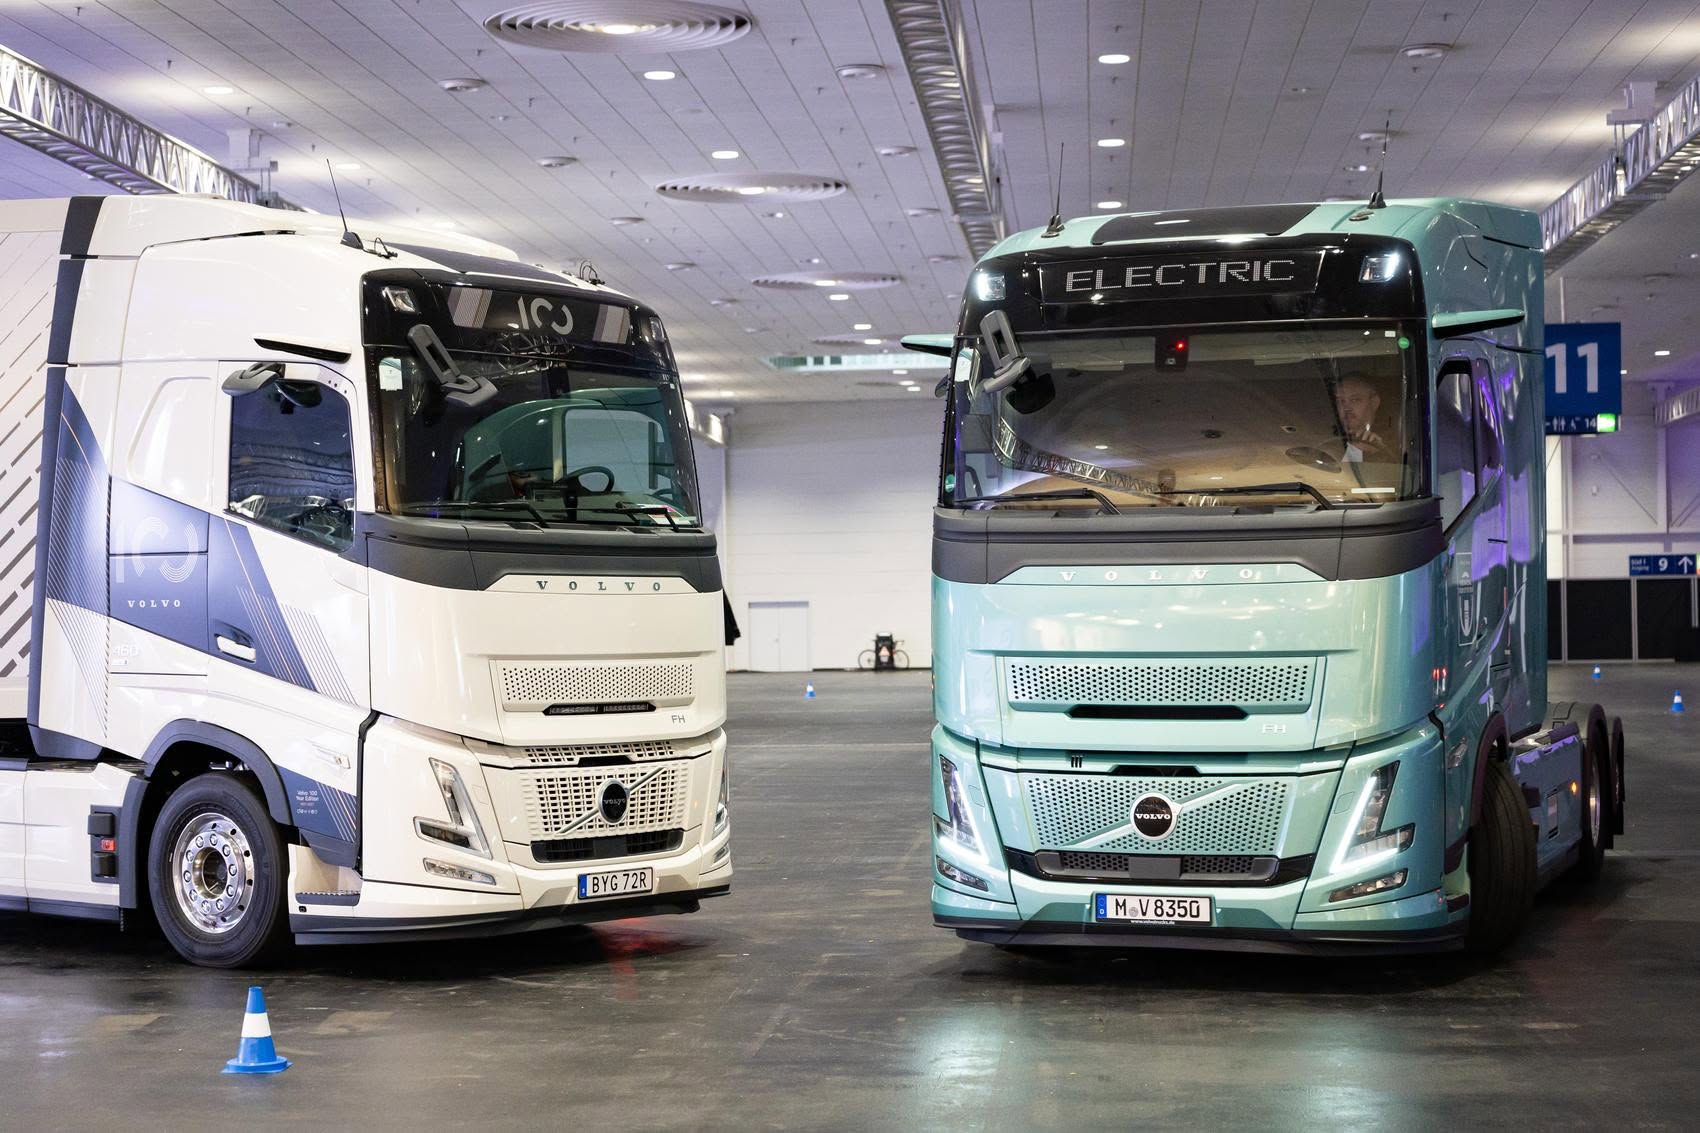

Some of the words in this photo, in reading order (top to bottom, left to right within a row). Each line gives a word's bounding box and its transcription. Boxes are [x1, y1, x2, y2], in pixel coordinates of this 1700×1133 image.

[1066, 260, 1294, 292] ELECTRIC
[1545, 342, 1599, 395] 11
[1658, 557, 1669, 572] 9
[1060, 568, 1255, 582] VOLVO
[536, 580, 661, 592] VOLVO
[127, 599, 181, 608] VOLVO
[671, 714, 686, 724] FH
[1262, 723, 1286, 734] FH
[592, 875, 618, 893] BYG
[623, 872, 647, 890] 72R
[1115, 898, 1127, 916] M
[1139, 899, 1150, 916] V
[1154, 899, 1200, 918] 8350
